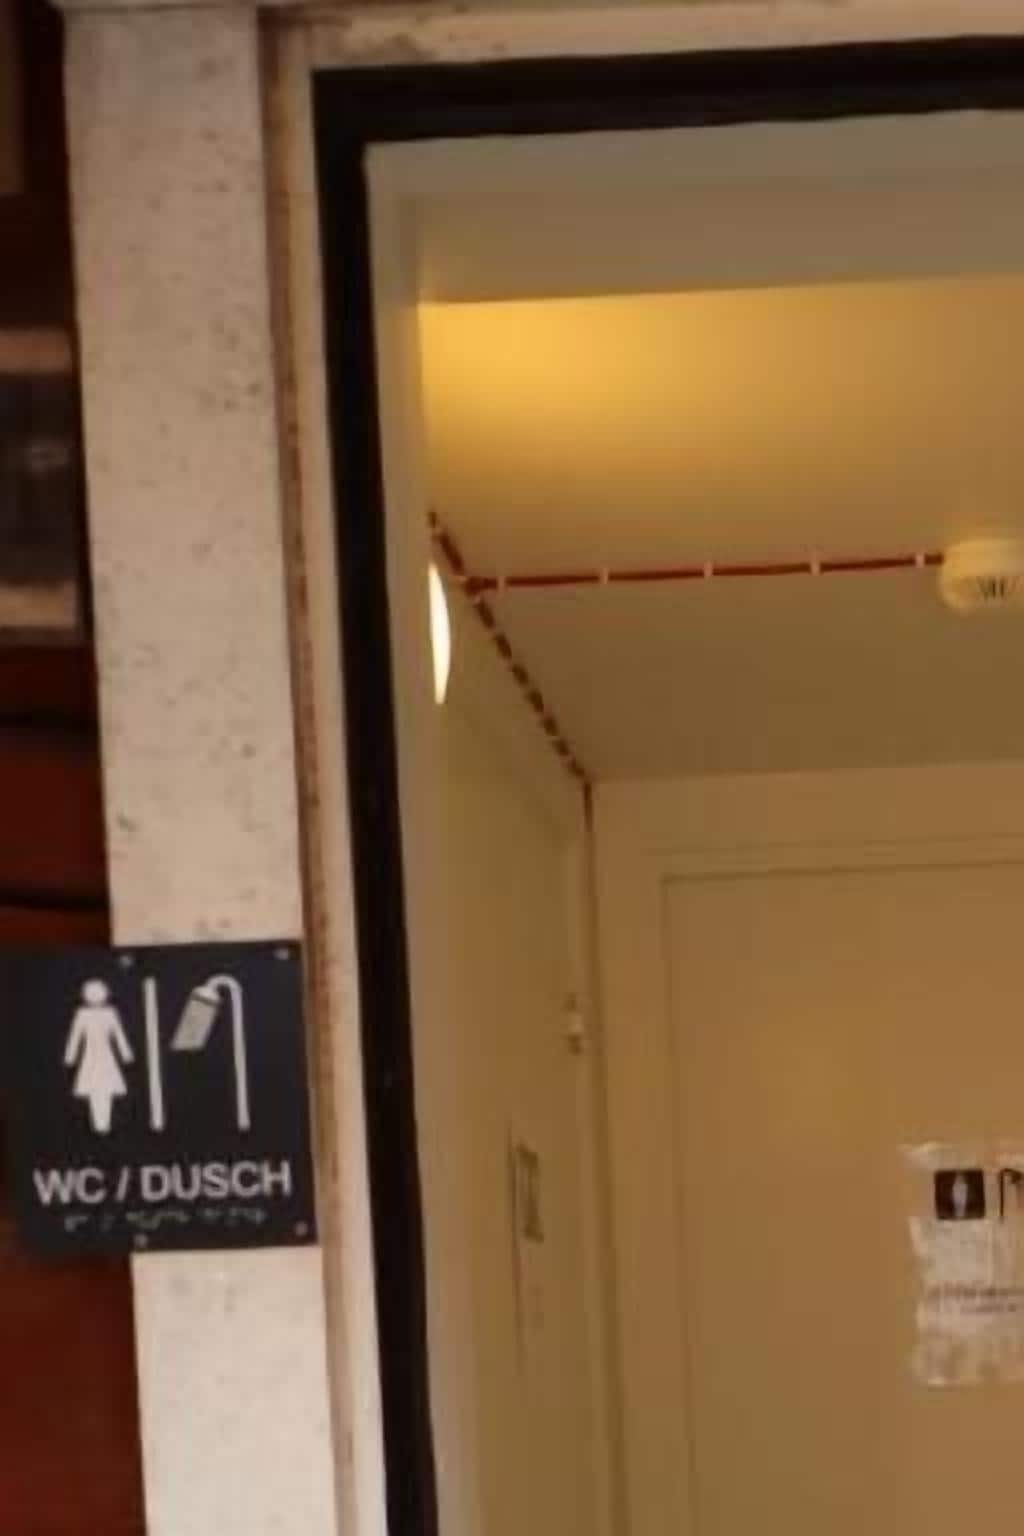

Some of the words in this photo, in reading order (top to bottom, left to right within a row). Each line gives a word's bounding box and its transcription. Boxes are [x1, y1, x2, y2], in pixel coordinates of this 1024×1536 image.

[33, 1168, 106, 1205] WC
[115, 1167, 129, 1201] /
[140, 1160, 291, 1202] DUSCH
